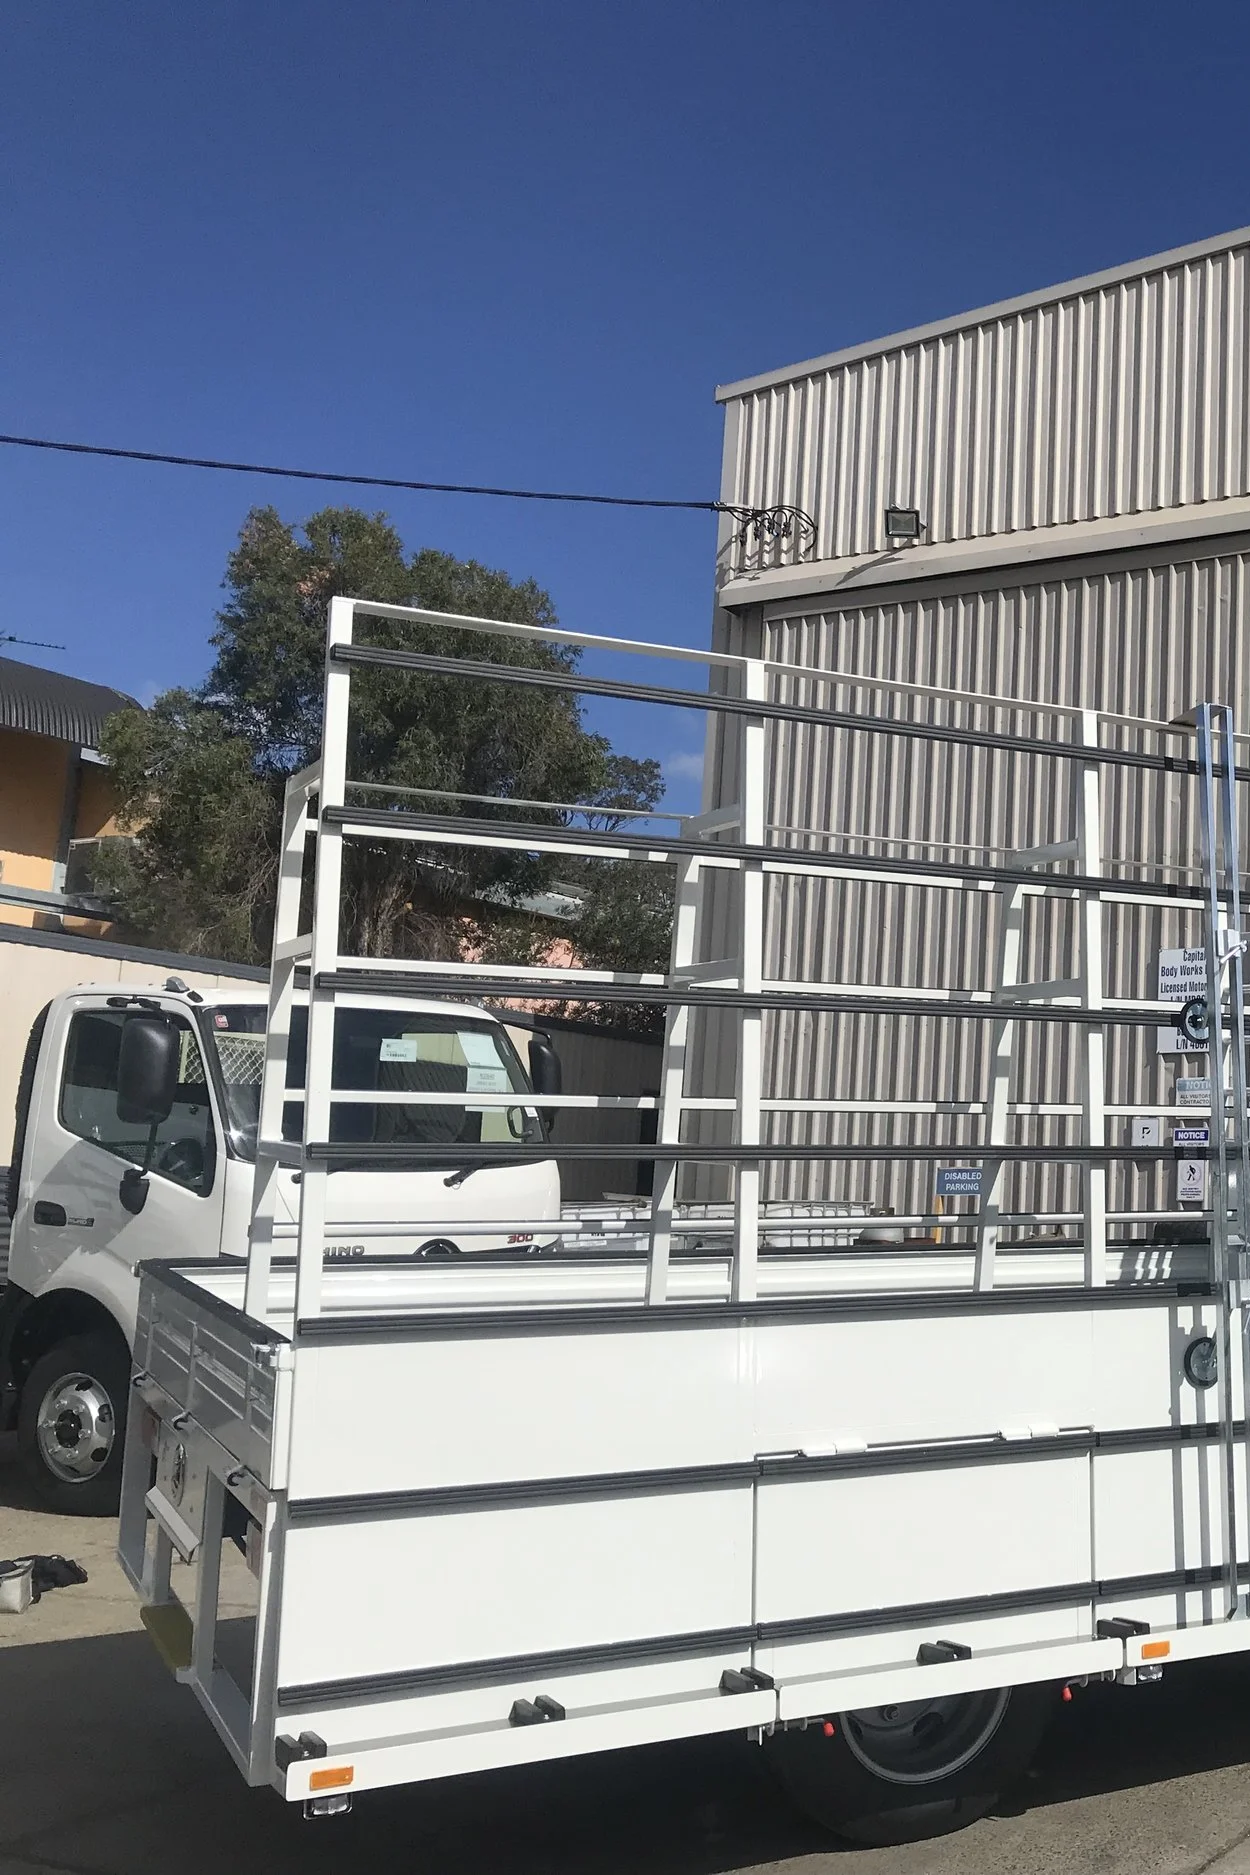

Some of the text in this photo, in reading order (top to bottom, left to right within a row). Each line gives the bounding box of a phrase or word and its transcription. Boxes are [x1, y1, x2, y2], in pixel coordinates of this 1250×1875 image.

[1183, 950, 1206, 963] Capita
[1161, 966, 1178, 978] Body
[1180, 965, 1203, 976] Works
[1160, 982, 1187, 993] Licensed
[1178, 1131, 1205, 1139] NOTICE
[945, 1172, 982, 1180] DISABLED
[946, 1183, 979, 1191] PARKING
[507, 1233, 533, 1244] 300
